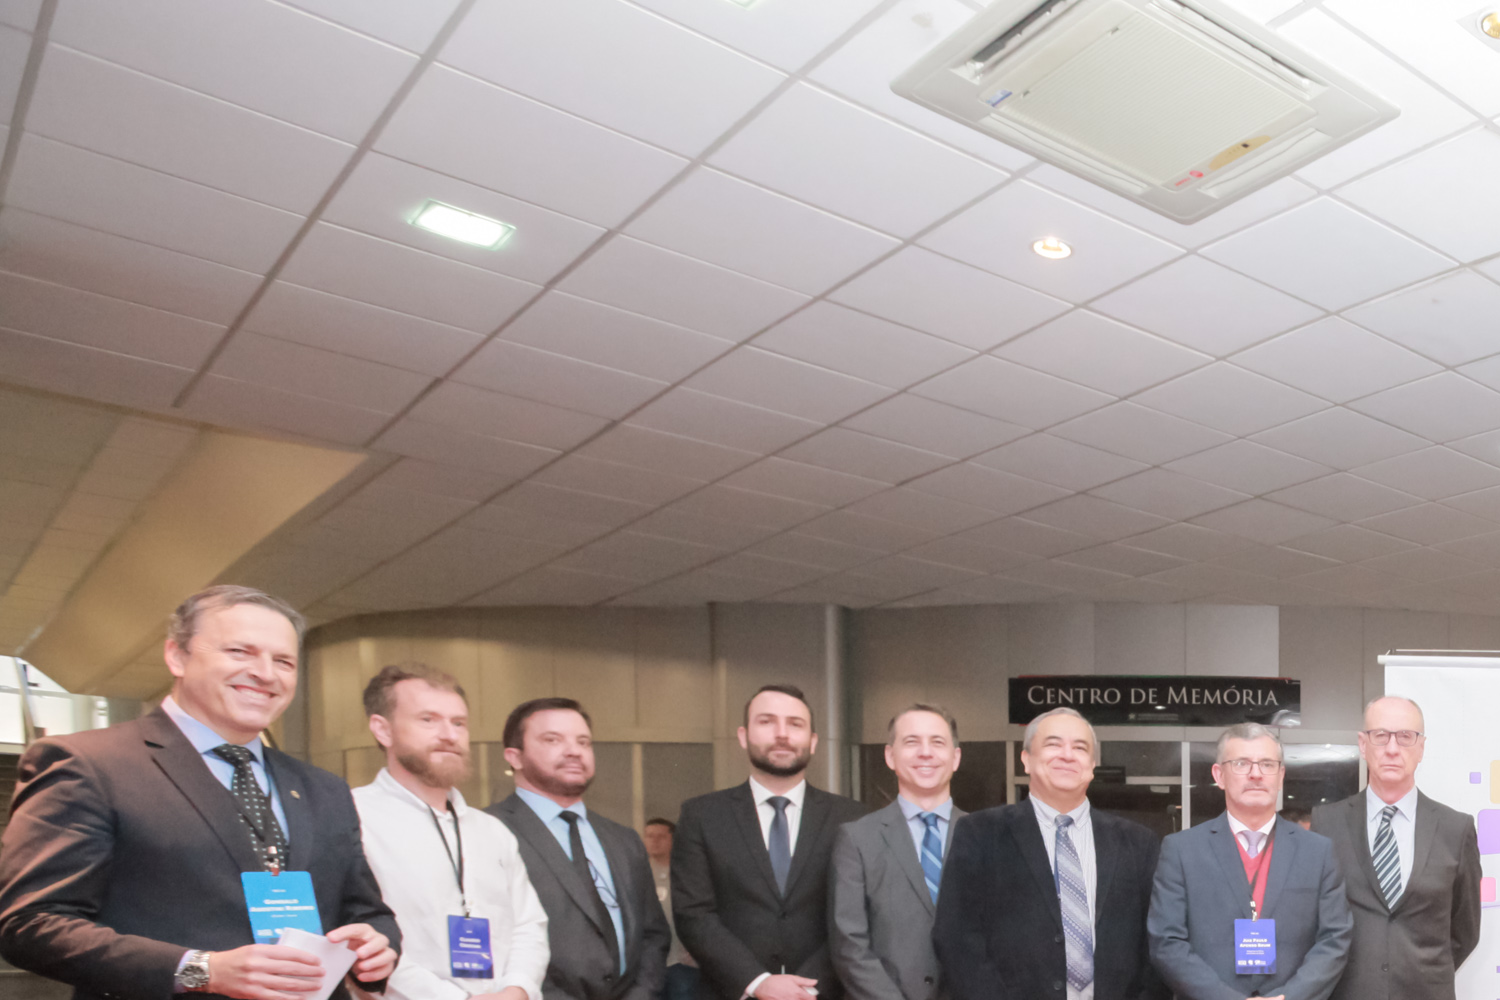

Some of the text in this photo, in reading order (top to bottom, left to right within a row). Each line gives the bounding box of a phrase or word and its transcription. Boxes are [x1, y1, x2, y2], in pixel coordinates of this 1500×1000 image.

[1027, 685, 1279, 706] CENTRO DE MEMÓRIA
